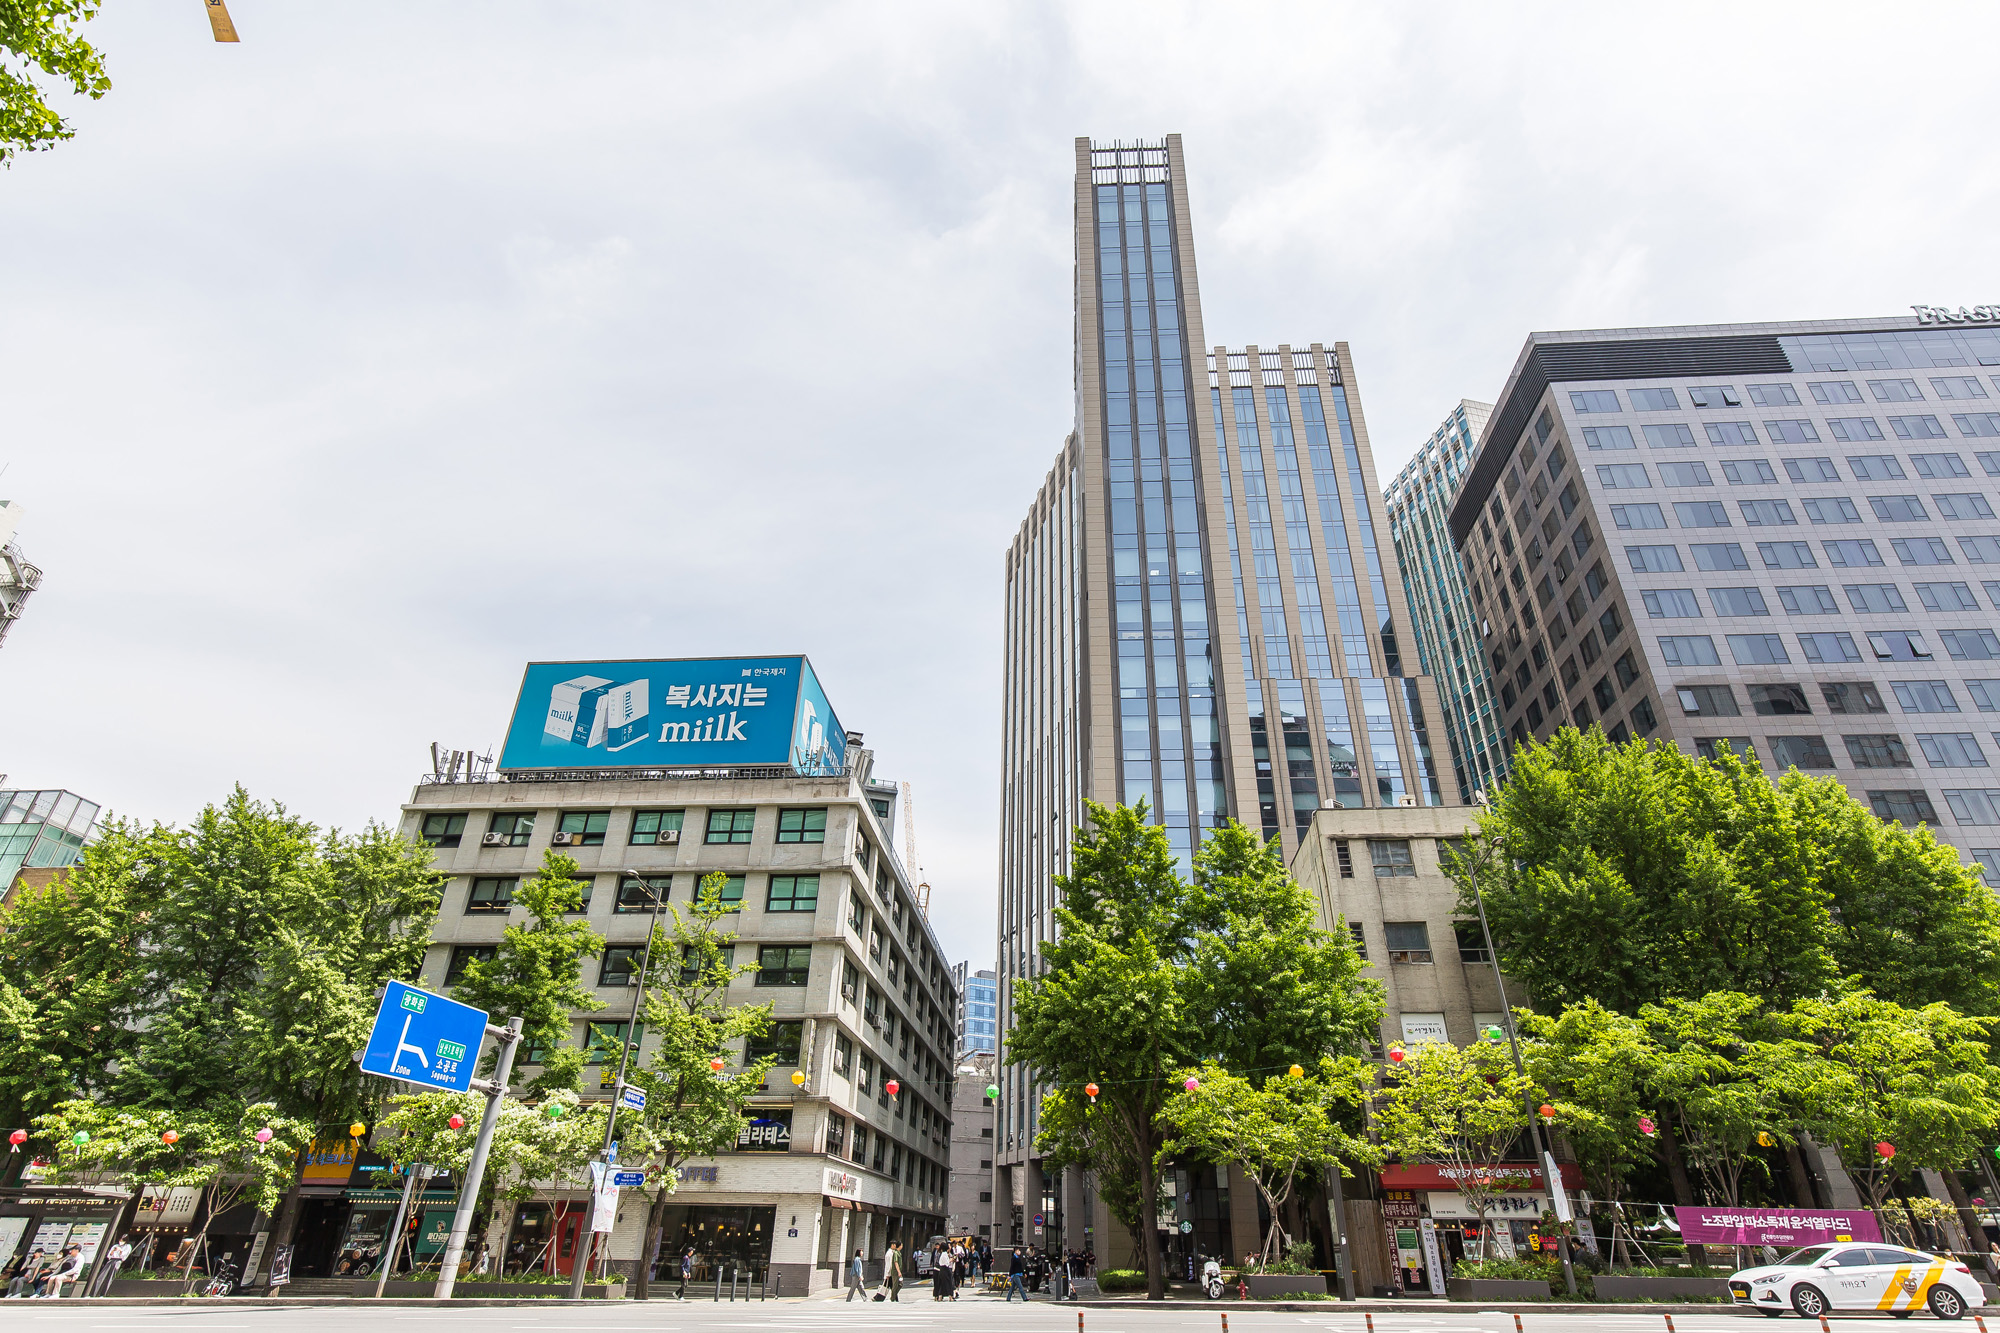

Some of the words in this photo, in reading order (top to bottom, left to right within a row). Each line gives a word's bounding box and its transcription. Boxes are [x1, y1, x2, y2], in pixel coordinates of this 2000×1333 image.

[754, 667, 786, 677] 한국제지
[665, 683, 768, 709] 복사지는
[550, 708, 574, 723] miilk
[657, 710, 748, 743] miilk
[403, 994, 426, 1011] 광화문
[439, 1042, 464, 1059] 남산3호터널
[395, 1065, 411, 1076] 200m
[435, 1058, 458, 1073] 소공로
[430, 1070, 457, 1083] Sogong-ro
[738, 1126, 791, 1145] 필라테스
[1701, 1214, 1745, 1228] 노조탄압
[1744, 1215, 1790, 1229] 파쇼독재
[1790, 1216, 1853, 1231] 윤석열타도!
[1840, 1280, 1867, 1288] 카카오T
